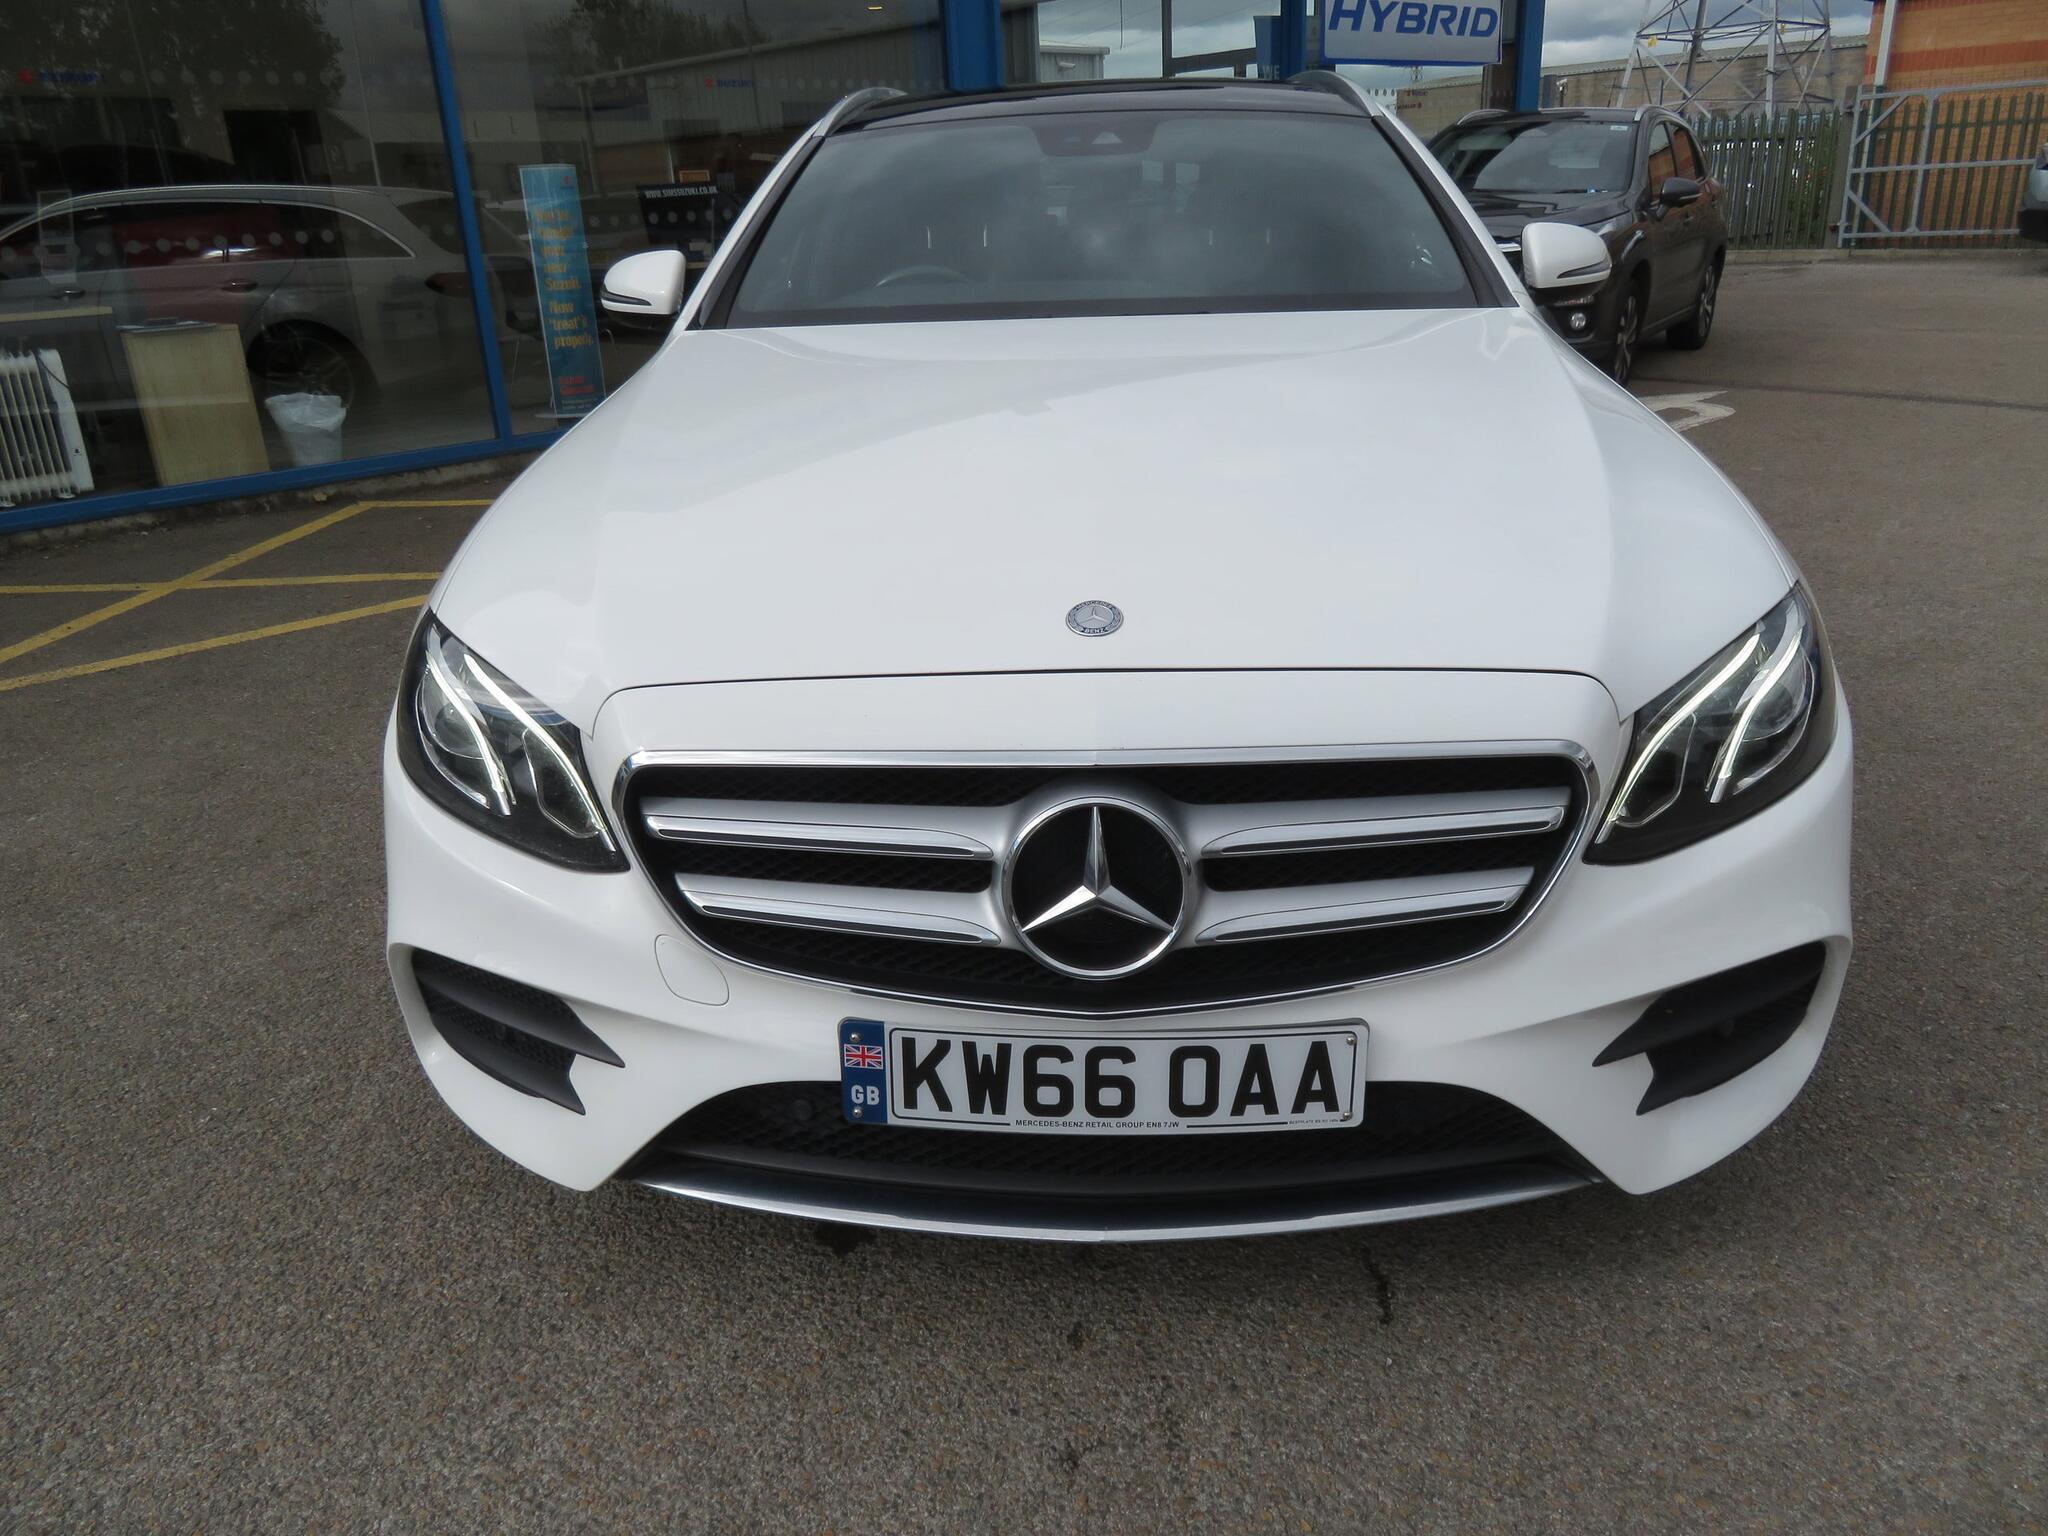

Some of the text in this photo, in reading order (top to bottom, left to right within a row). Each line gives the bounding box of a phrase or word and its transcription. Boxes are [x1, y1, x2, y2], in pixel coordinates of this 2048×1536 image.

[1328, 0, 1498, 37] HYBRID
[900, 1036, 1341, 1119] KW66 OAA
[850, 1084, 880, 1106] GB
[1015, 1119, 1084, 1128] MERCEDES-BENZ
